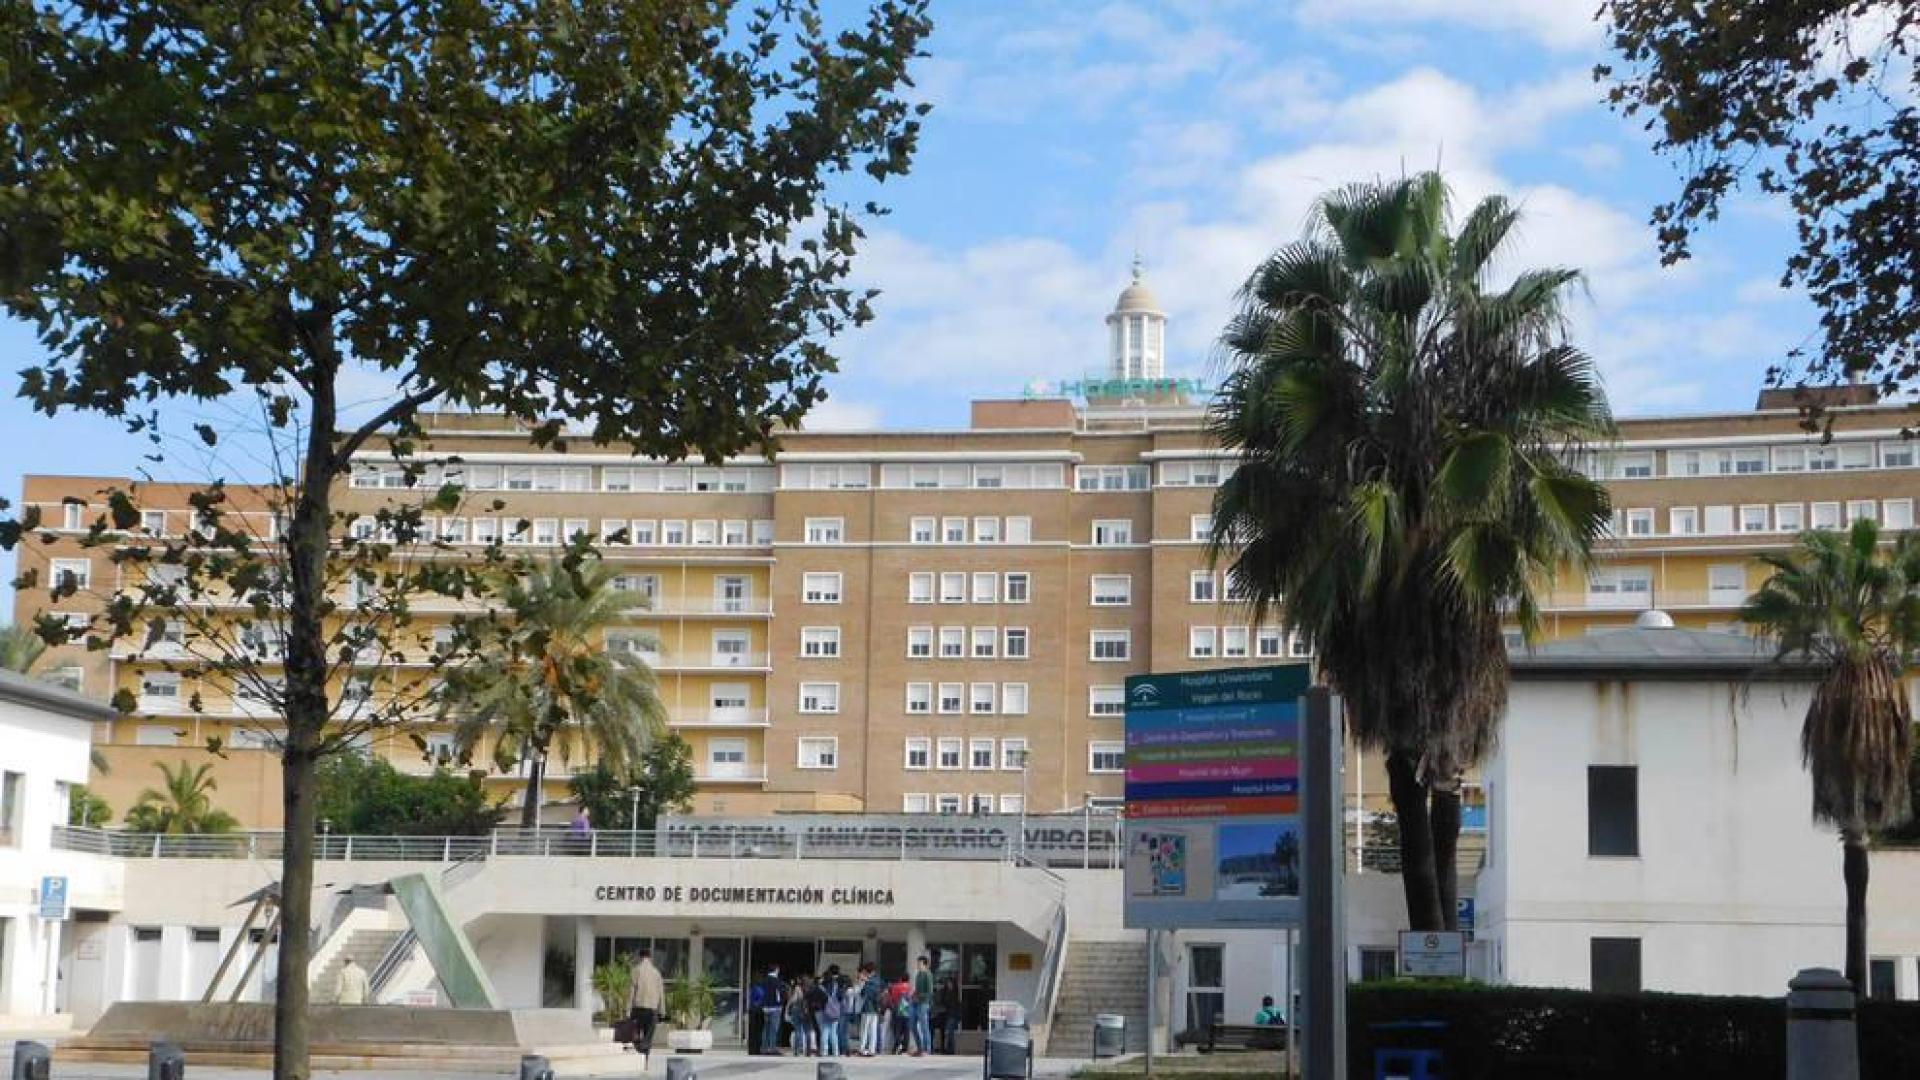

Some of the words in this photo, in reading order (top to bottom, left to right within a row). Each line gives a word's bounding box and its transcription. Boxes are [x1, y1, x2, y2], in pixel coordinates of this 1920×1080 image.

[1060, 377, 1212, 396] HOSPITAL
[1181, 674, 1216, 686] Hospital
[1191, 691, 1218, 704] Virgen
[1222, 690, 1234, 700] del
[1179, 767, 1209, 778] Hospital
[1233, 784, 1264, 795] Hospital
[668, 824, 792, 847] HOSPITAL
[807, 826, 1005, 849] UNIVERSITARIO
[1023, 828, 1122, 851] VIRGEN
[595, 885, 656, 901] CENTRO
[663, 886, 683, 902] DE
[690, 886, 823, 905] DOCUMENTACIÓN
[831, 886, 894, 906] CLÍNICA
